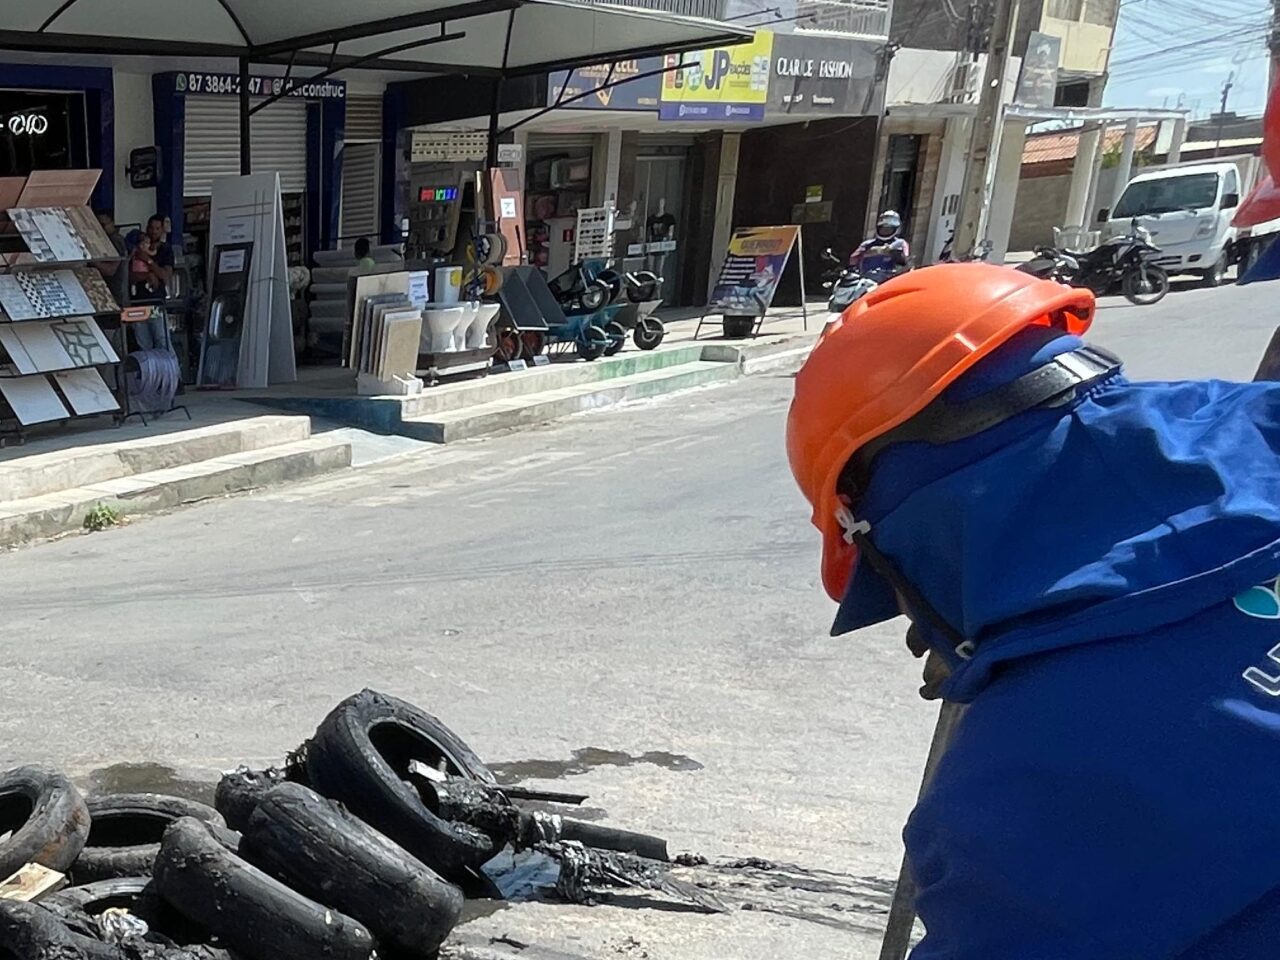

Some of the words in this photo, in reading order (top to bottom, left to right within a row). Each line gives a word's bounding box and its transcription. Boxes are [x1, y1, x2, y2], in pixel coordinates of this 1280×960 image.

[819, 60, 854, 78] FASHION
[189, 73, 203, 91] 87
[205, 75, 261, 94] 3864-247
